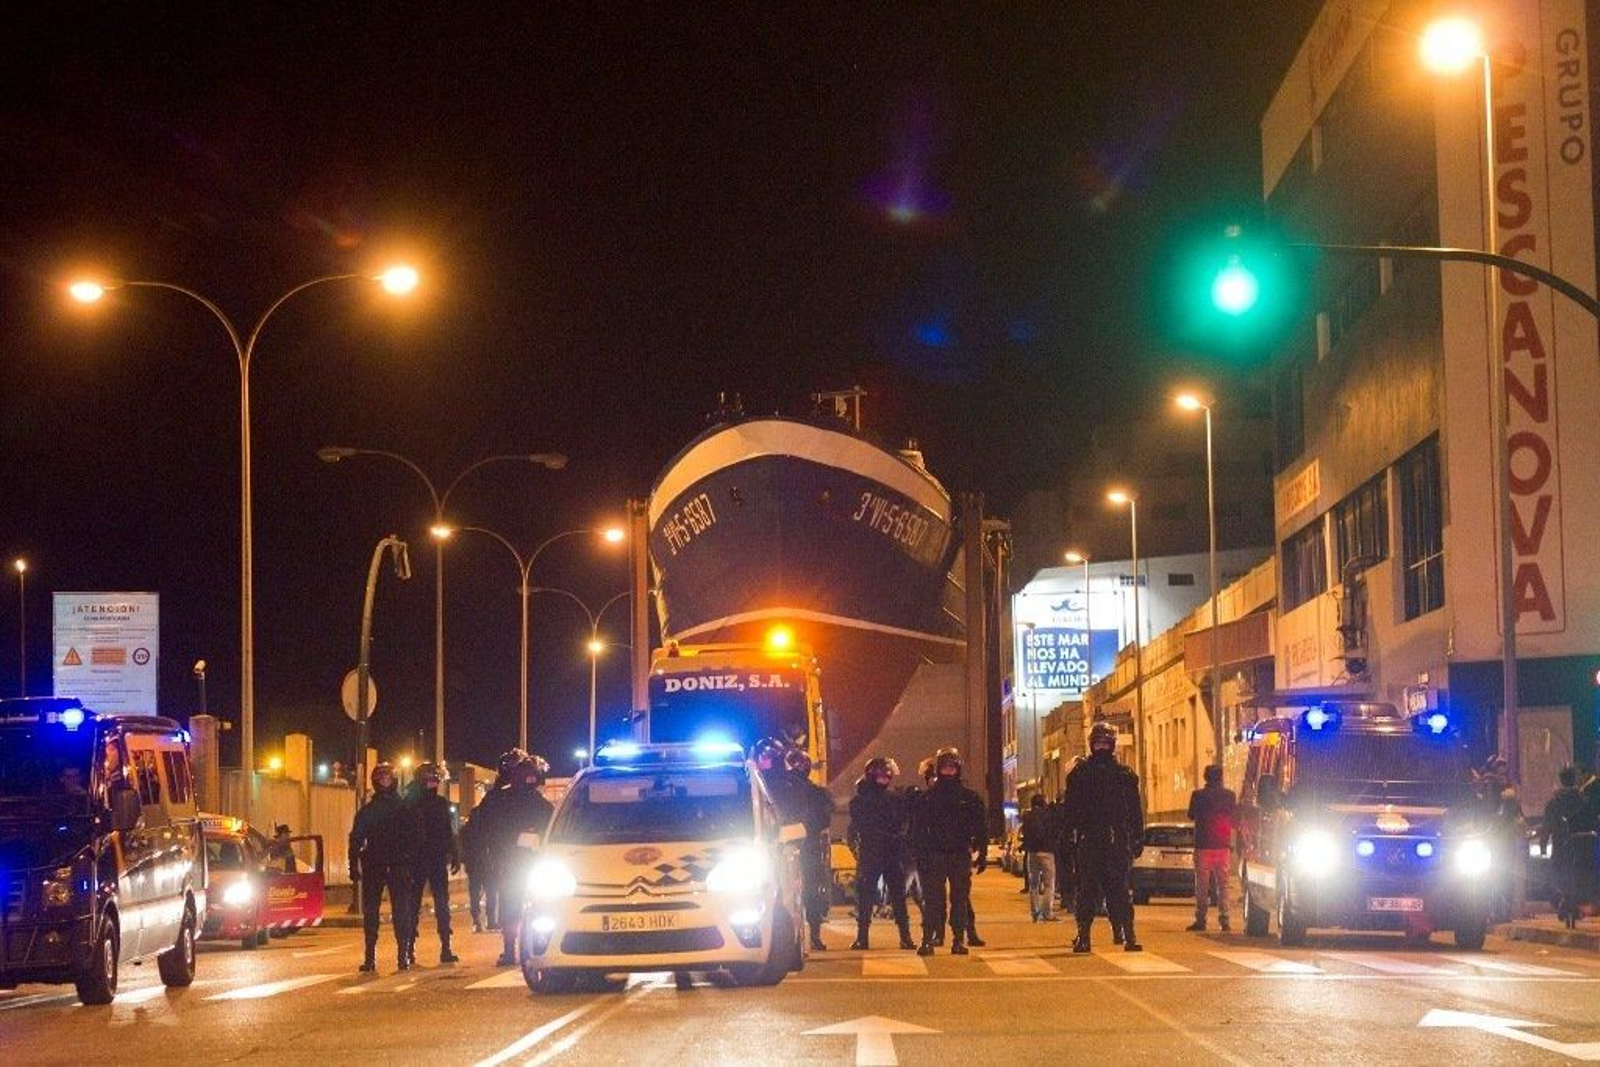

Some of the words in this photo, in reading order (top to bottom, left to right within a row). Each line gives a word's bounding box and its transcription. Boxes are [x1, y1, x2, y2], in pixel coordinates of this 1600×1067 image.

[1556, 28, 1585, 165] GRUPO
[1494, 40, 1557, 623] PESCANOVA
[1026, 634, 1055, 647] ESTE
[1059, 634, 1088, 647] MAR
[1027, 648, 1056, 660] NOS
[1060, 648, 1080, 660] HA
[1027, 661, 1088, 674] LLEVADO
[665, 675, 744, 692] DONIZ,
[749, 674, 790, 688] S.A.
[1026, 676, 1044, 688] AL
[1048, 674, 1099, 687] MUNDO
[612, 917, 645, 929] 2643
